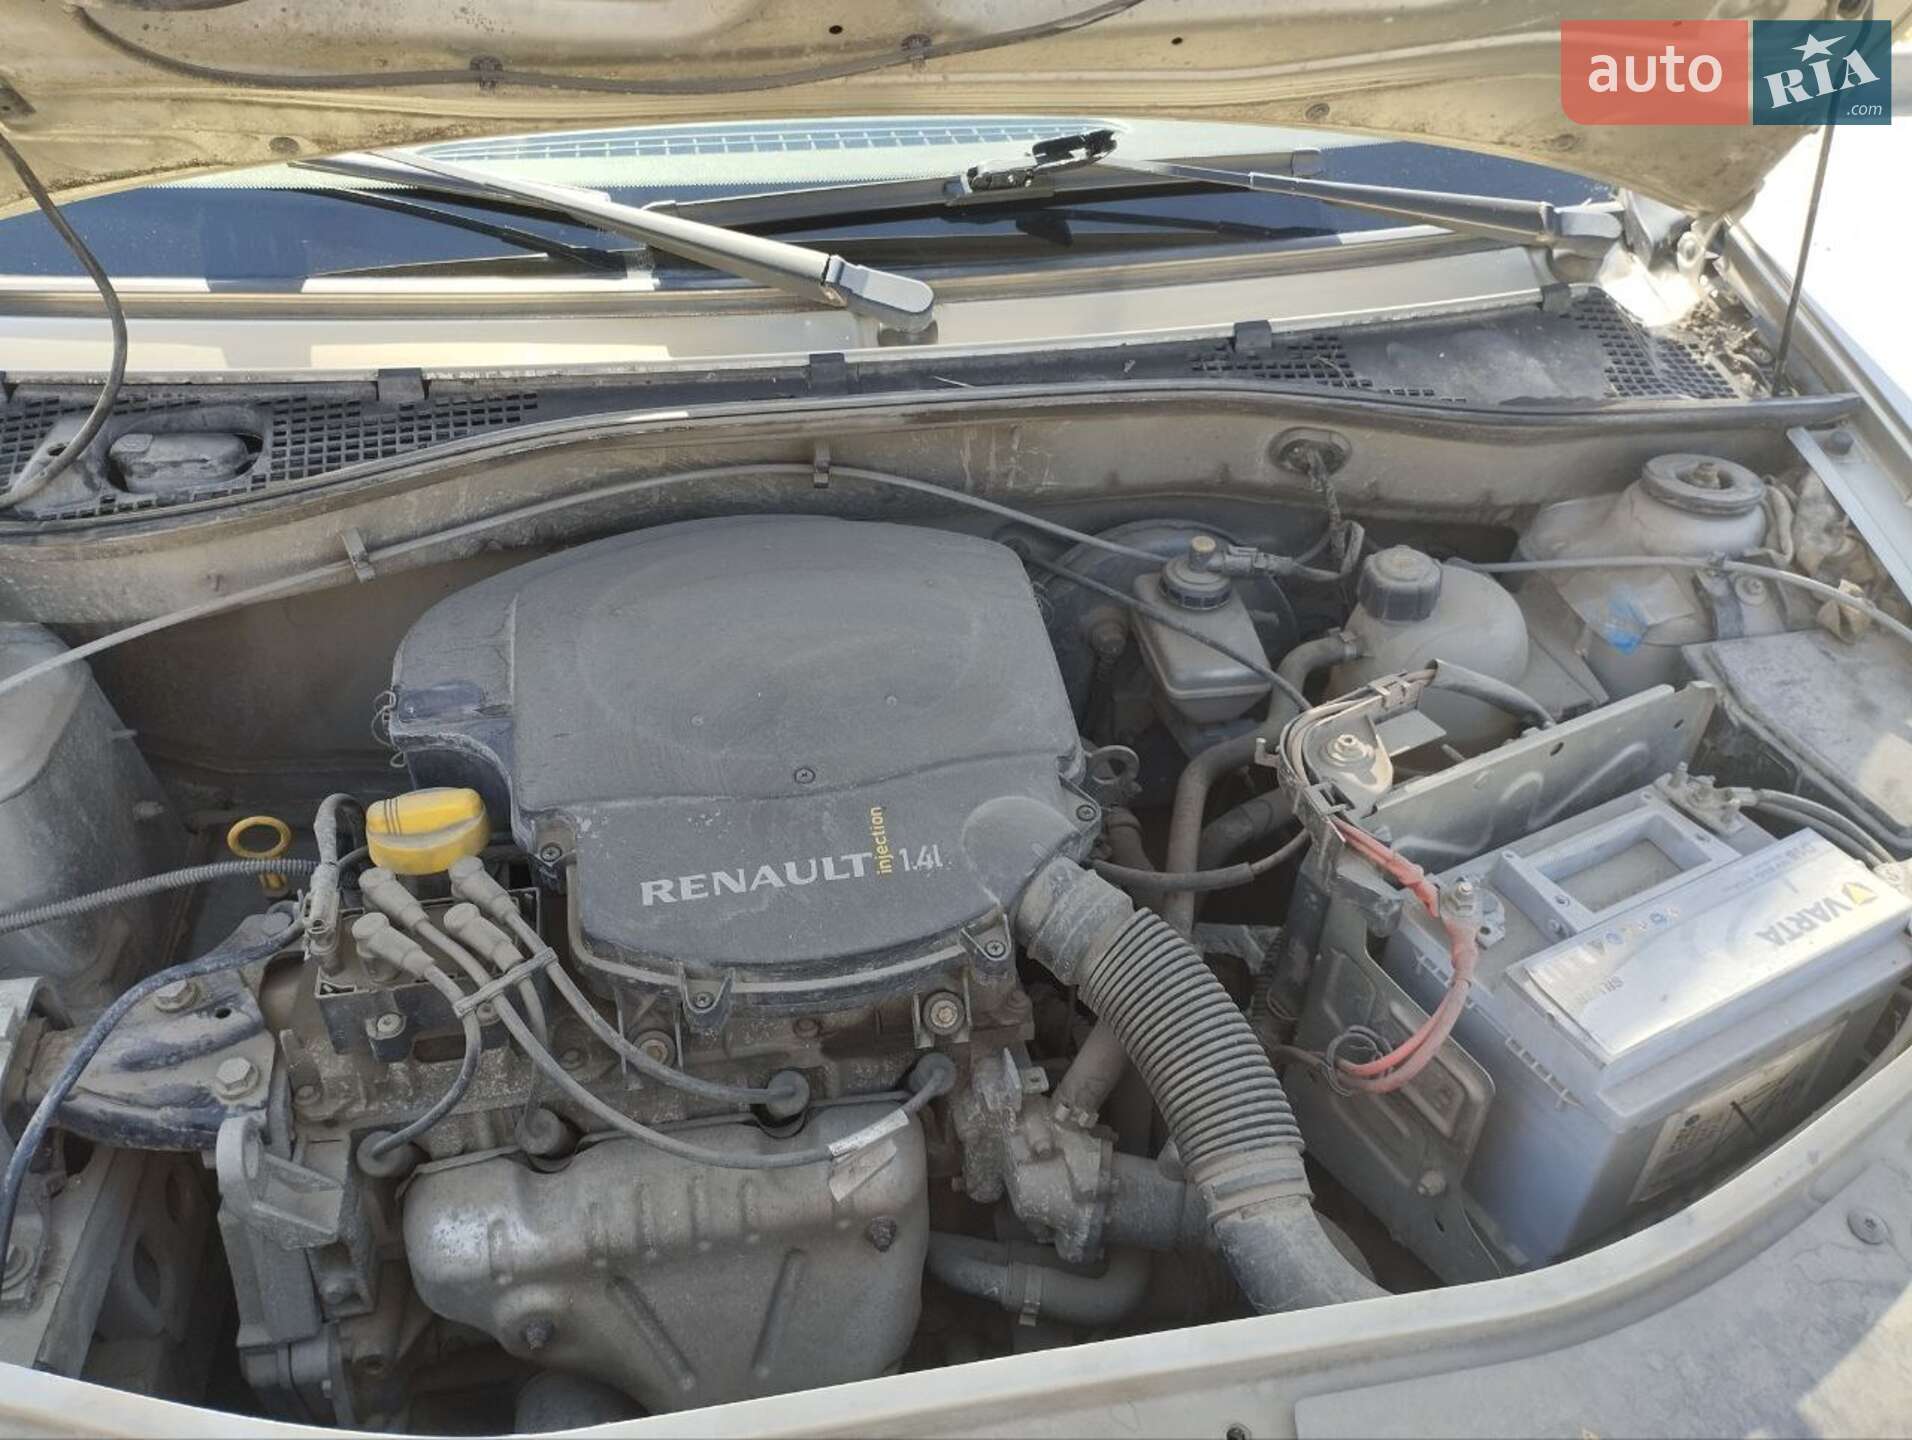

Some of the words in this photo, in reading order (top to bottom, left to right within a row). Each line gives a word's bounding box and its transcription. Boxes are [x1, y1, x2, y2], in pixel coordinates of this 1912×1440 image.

[870, 807, 894, 875] injection
[640, 852, 872, 907] RENAULT
[1754, 897, 1854, 947] VARTA
